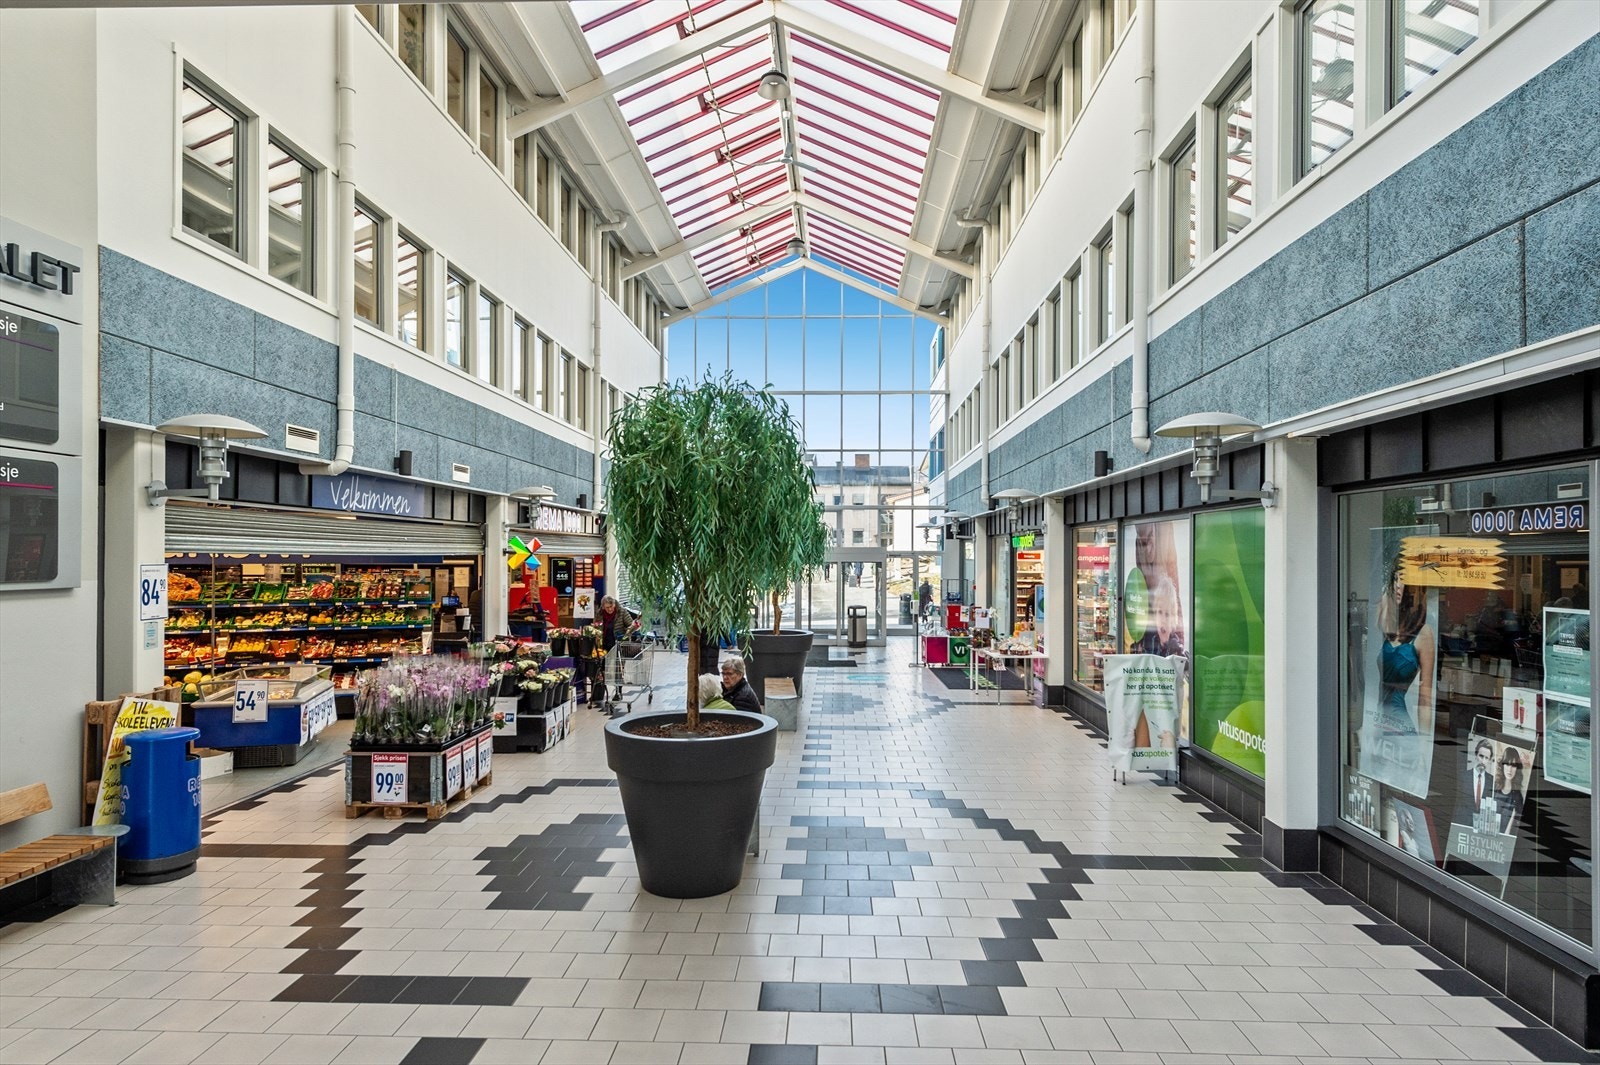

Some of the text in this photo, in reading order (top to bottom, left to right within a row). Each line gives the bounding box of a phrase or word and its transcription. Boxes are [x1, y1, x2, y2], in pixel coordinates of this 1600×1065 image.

[0, 462, 19, 482] sje
[331, 476, 411, 514] Velkommen
[563, 510, 581, 534] 1000
[142, 579, 160, 606] 84
[133, 701, 148, 715] TIL
[236, 691, 256, 711] 54
[389, 754, 406, 762] prisen
[376, 772, 404, 793] 99 00
[1349, 775, 1358, 784] NY
[1470, 835, 1504, 852] STYLING
[1470, 846, 1486, 859] FOR
[1487, 851, 1505, 864] ALLE
